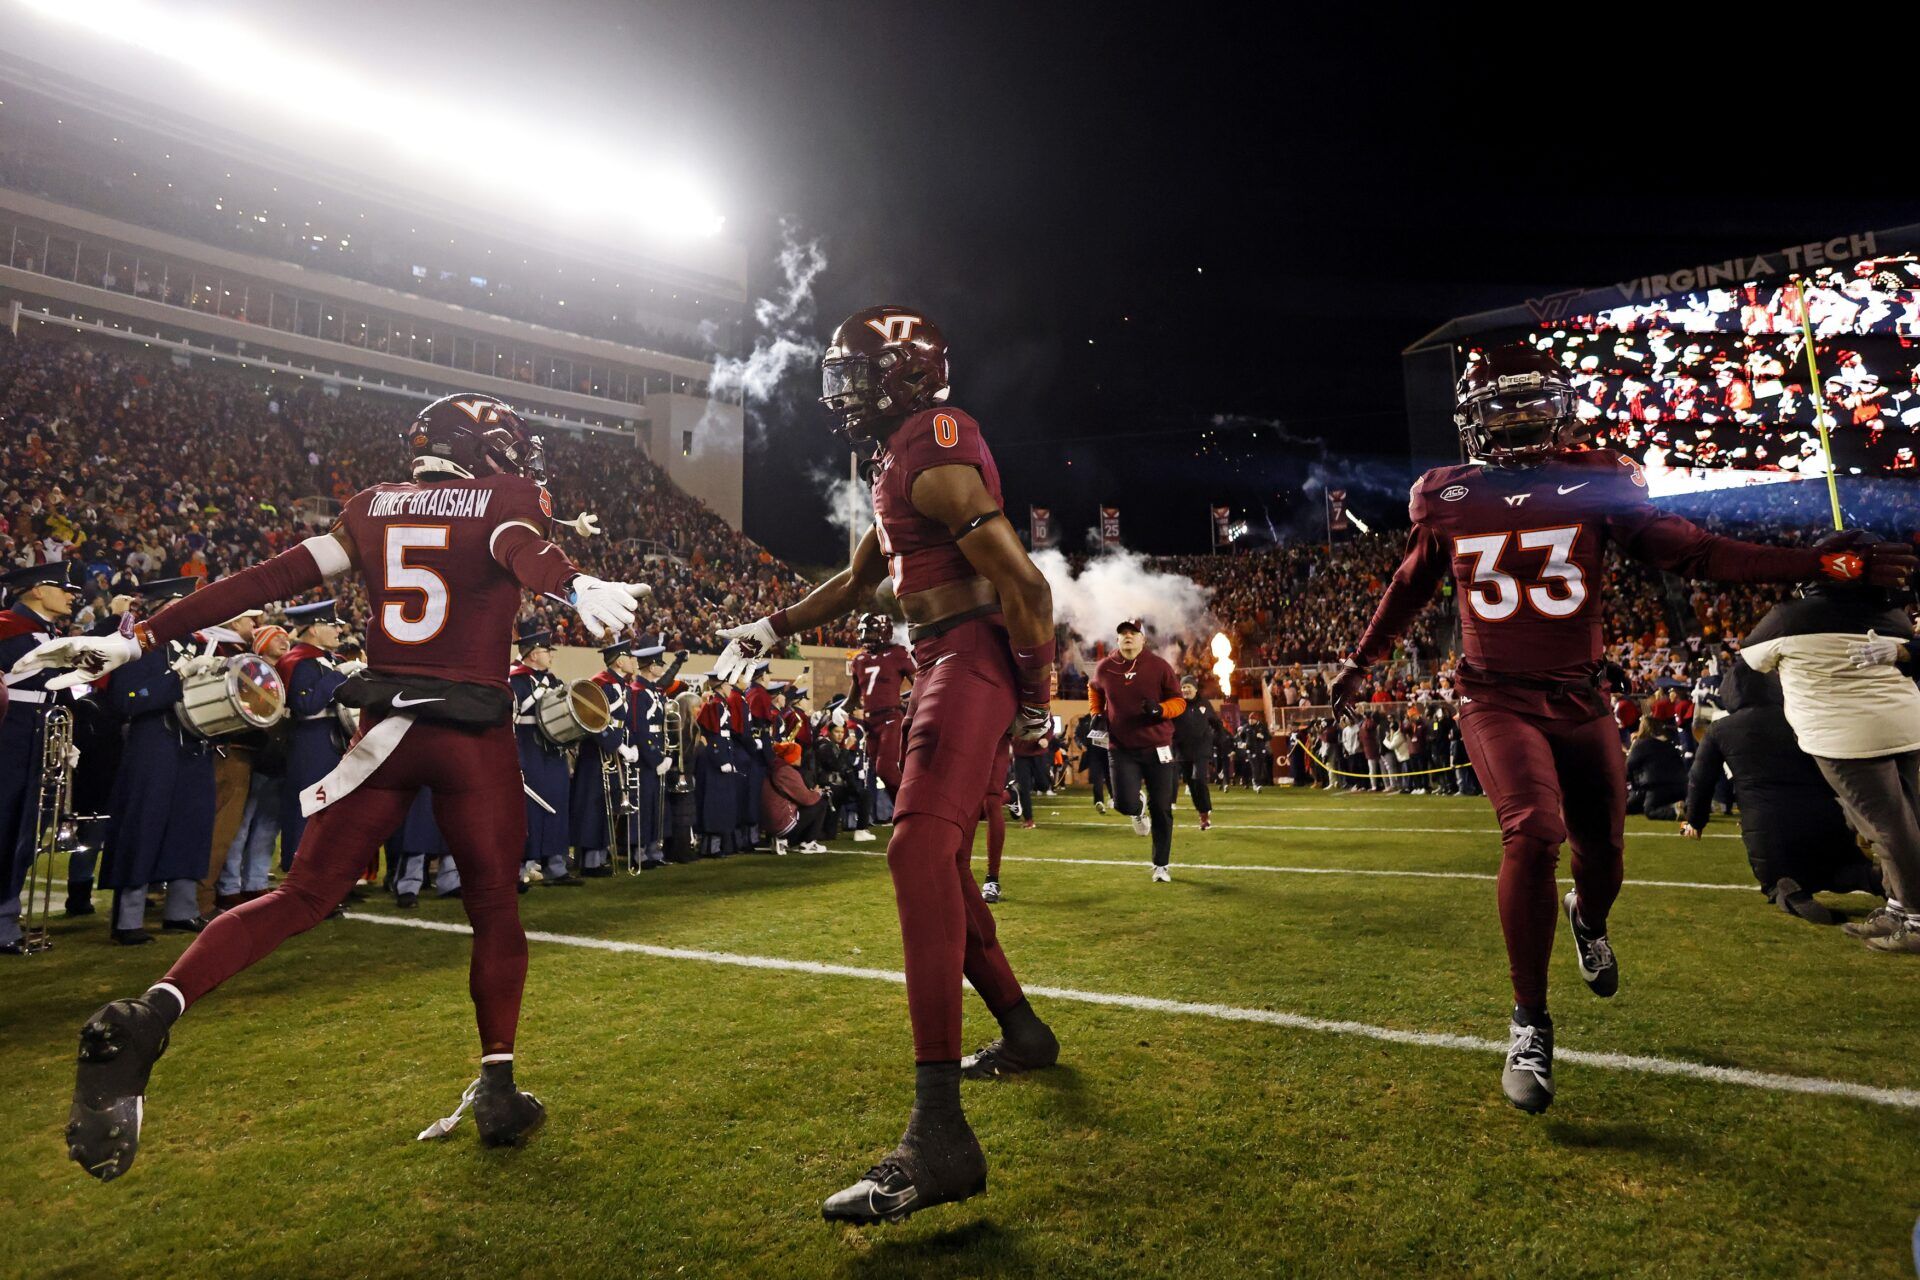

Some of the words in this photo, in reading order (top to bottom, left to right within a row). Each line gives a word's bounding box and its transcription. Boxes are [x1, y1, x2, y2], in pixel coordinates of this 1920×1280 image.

[1615, 254, 1776, 301] VIRGINIA
[1782, 231, 1877, 267] TECH
[1524, 288, 1585, 320] VT
[864, 315, 922, 343] VT
[933, 413, 959, 448] 0
[367, 487, 493, 518] TURNER-BRADSHAW
[1334, 507, 1342, 521] 7
[1504, 493, 1531, 506] VT
[1035, 526, 1047, 539] 10
[1104, 524, 1119, 537] 25
[381, 523, 451, 645] 5
[1453, 523, 1589, 623] 33
[864, 665, 881, 696] 7
[1124, 672, 1137, 680] VT
[315, 785, 327, 804] VT
